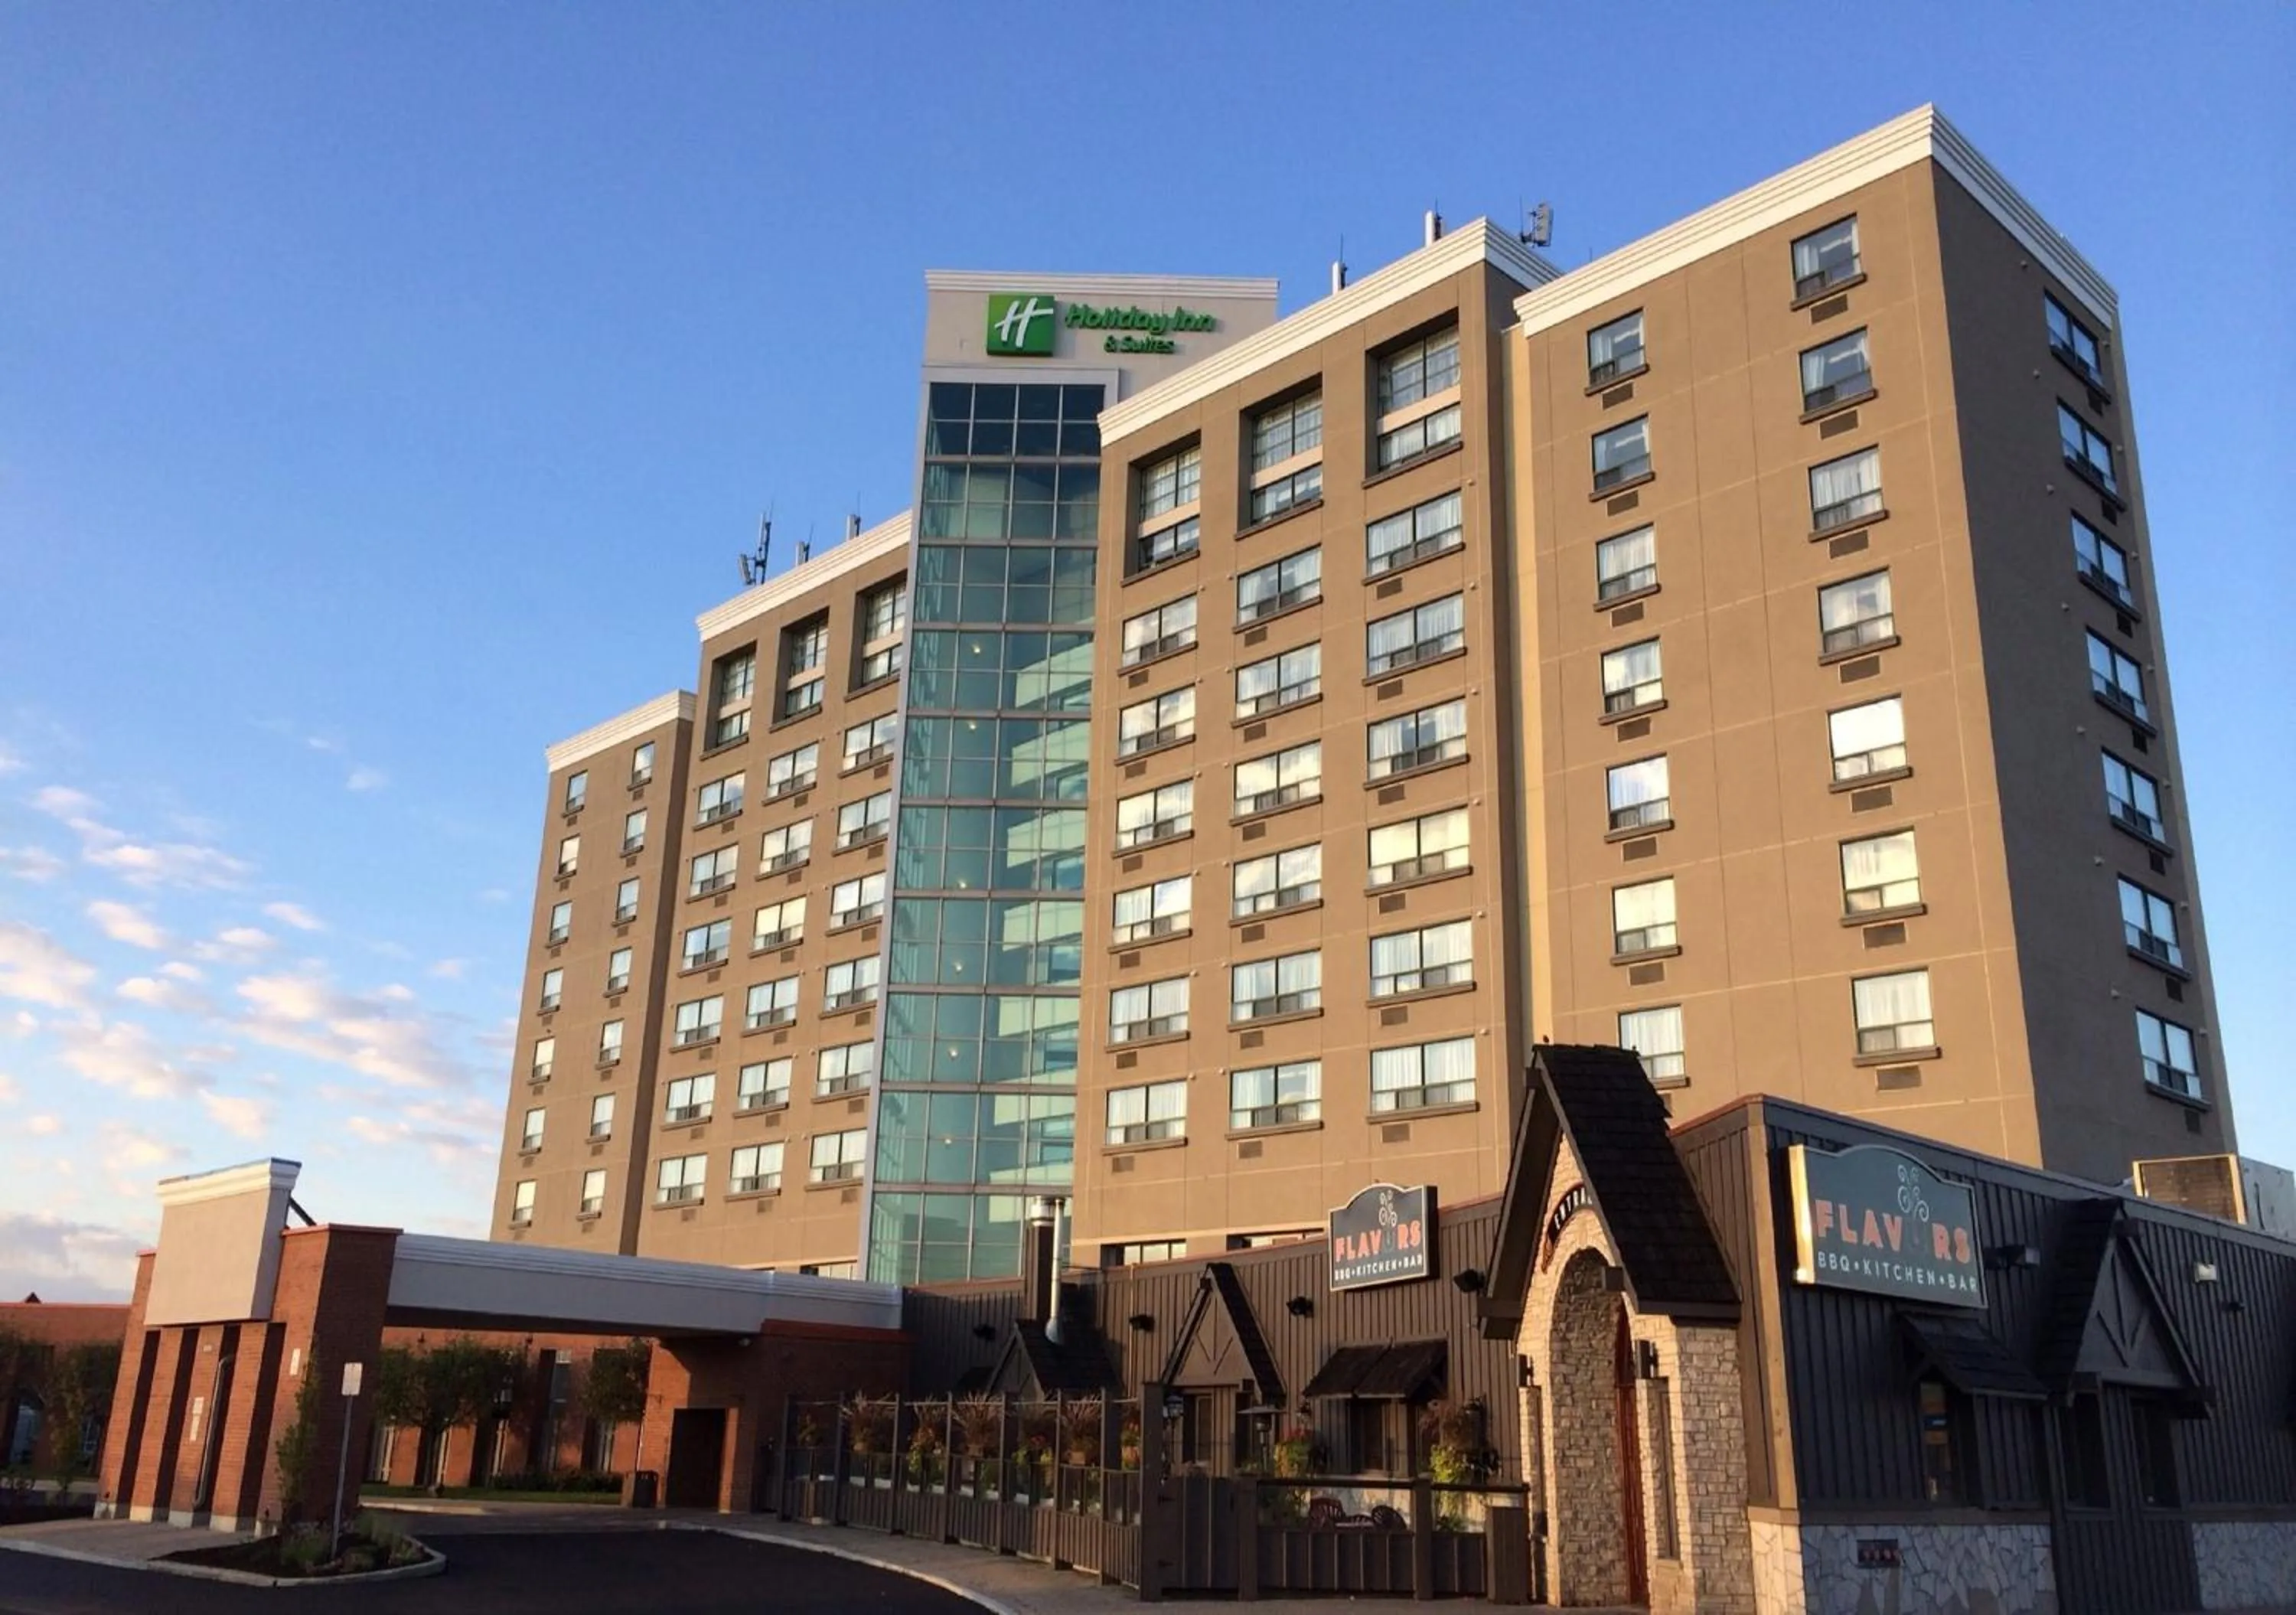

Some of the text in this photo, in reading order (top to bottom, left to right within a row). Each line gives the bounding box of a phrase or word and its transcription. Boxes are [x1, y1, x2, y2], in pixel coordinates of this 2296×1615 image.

[1065, 302, 1215, 335] Holiday Inn
[1104, 334, 1174, 354] & Suites
[1815, 1199, 1971, 1264] FLAVRS
[1357, 1259, 1397, 1277] KITCHEN
[1404, 1254, 1422, 1268] BAR
[1818, 1251, 1978, 1293] BBQ KITCHEN BAR
